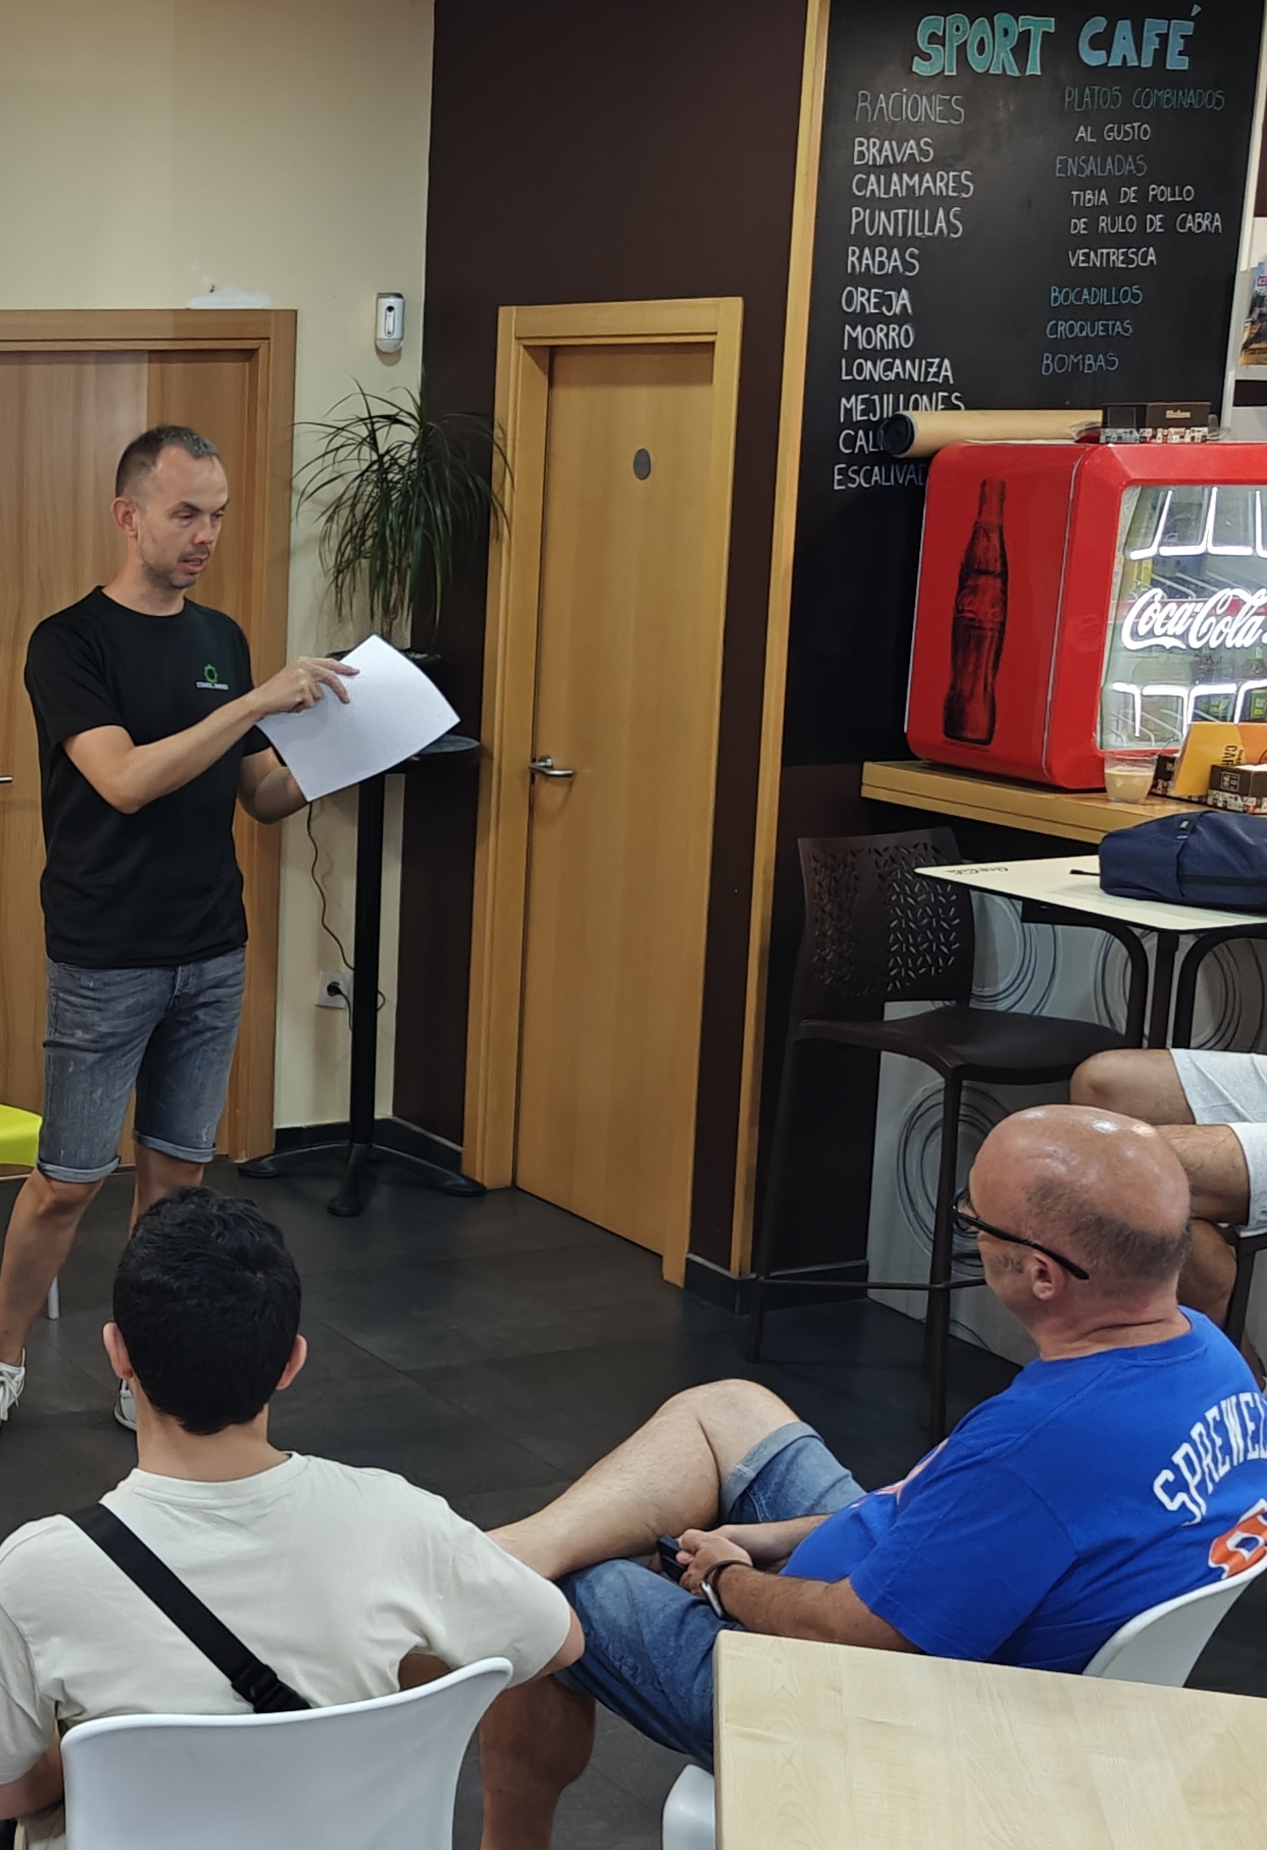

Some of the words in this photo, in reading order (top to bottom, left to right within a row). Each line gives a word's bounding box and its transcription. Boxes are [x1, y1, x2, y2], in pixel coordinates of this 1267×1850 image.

[912, 12, 1055, 77] SPORT
[1078, 4, 1202, 71] CAFÉ
[1064, 85, 1122, 112] PLATOS
[1132, 87, 1225, 111] COMBINADOS
[1075, 124, 1097, 143] AL
[1103, 123, 1151, 142] GUSTO
[853, 137, 934, 166] BRAVAS
[1055, 154, 1148, 178] ENSALADAS
[852, 170, 975, 199] CALAMARES
[1071, 188, 1109, 207] TIBIA
[1119, 186, 1139, 203] DE
[1148, 184, 1195, 202] POLLO
[849, 206, 963, 239] PUNTILLAS
[1070, 217, 1089, 235] DE
[1098, 214, 1138, 234] RULO
[1146, 214, 1165, 233] DE
[1176, 212, 1223, 233] CABRA
[847, 246, 920, 275] RABAS
[1068, 247, 1157, 268] VENTRESCA
[841, 287, 913, 316] OREJA
[1050, 285, 1144, 307] BOCADILLOS
[843, 323, 915, 351] MORRO
[1045, 319, 1133, 339] CROQUETAS
[840, 357, 955, 385] LONGANIZA
[1041, 352, 1120, 376] BOMBAS
[839, 392, 966, 424] MEJILLONES
[833, 463, 926, 491] ESCALIVAD
[1121, 588, 1267, 650] Coca-Cola
[1153, 1392, 1267, 1527] SPREWEL
